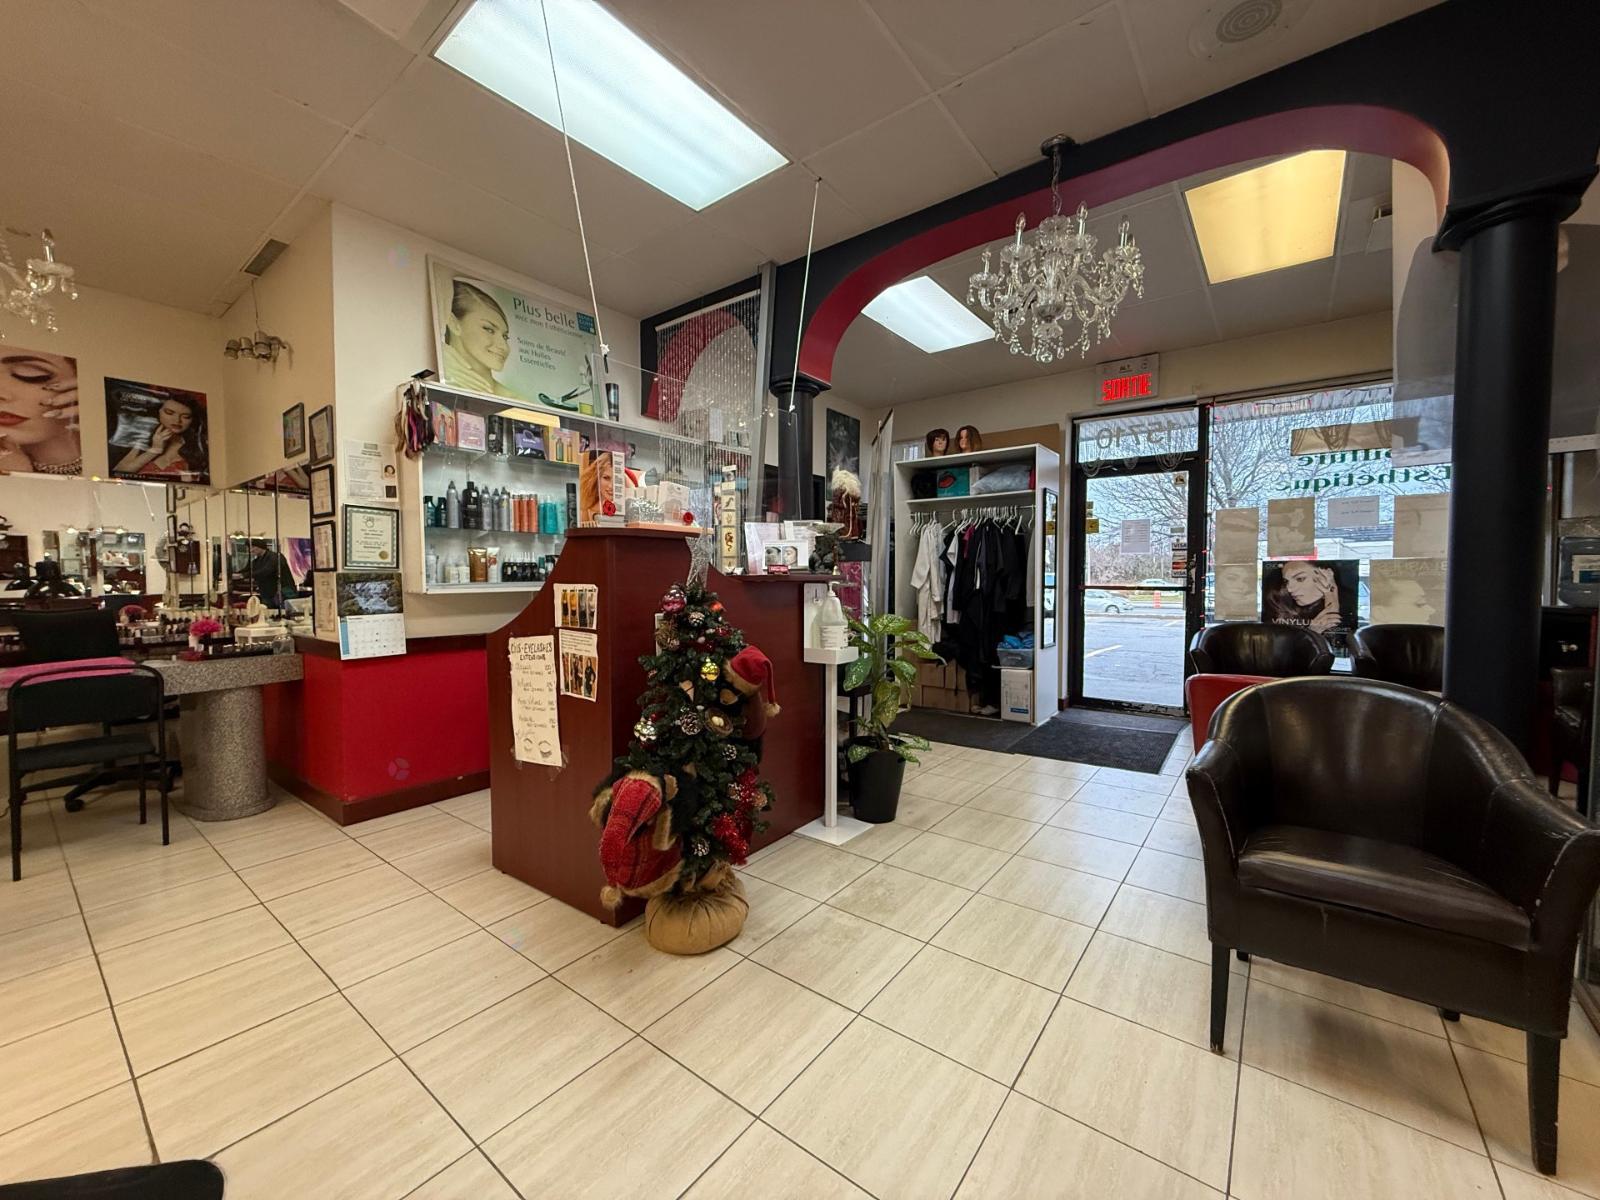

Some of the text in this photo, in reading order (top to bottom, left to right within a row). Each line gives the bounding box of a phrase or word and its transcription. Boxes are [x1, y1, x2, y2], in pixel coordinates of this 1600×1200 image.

[513, 297, 541, 318] Plus
[545, 307, 575, 329] belle
[1102, 371, 1152, 402] SORTIE
[1271, 617, 1311, 626] VINYLU
